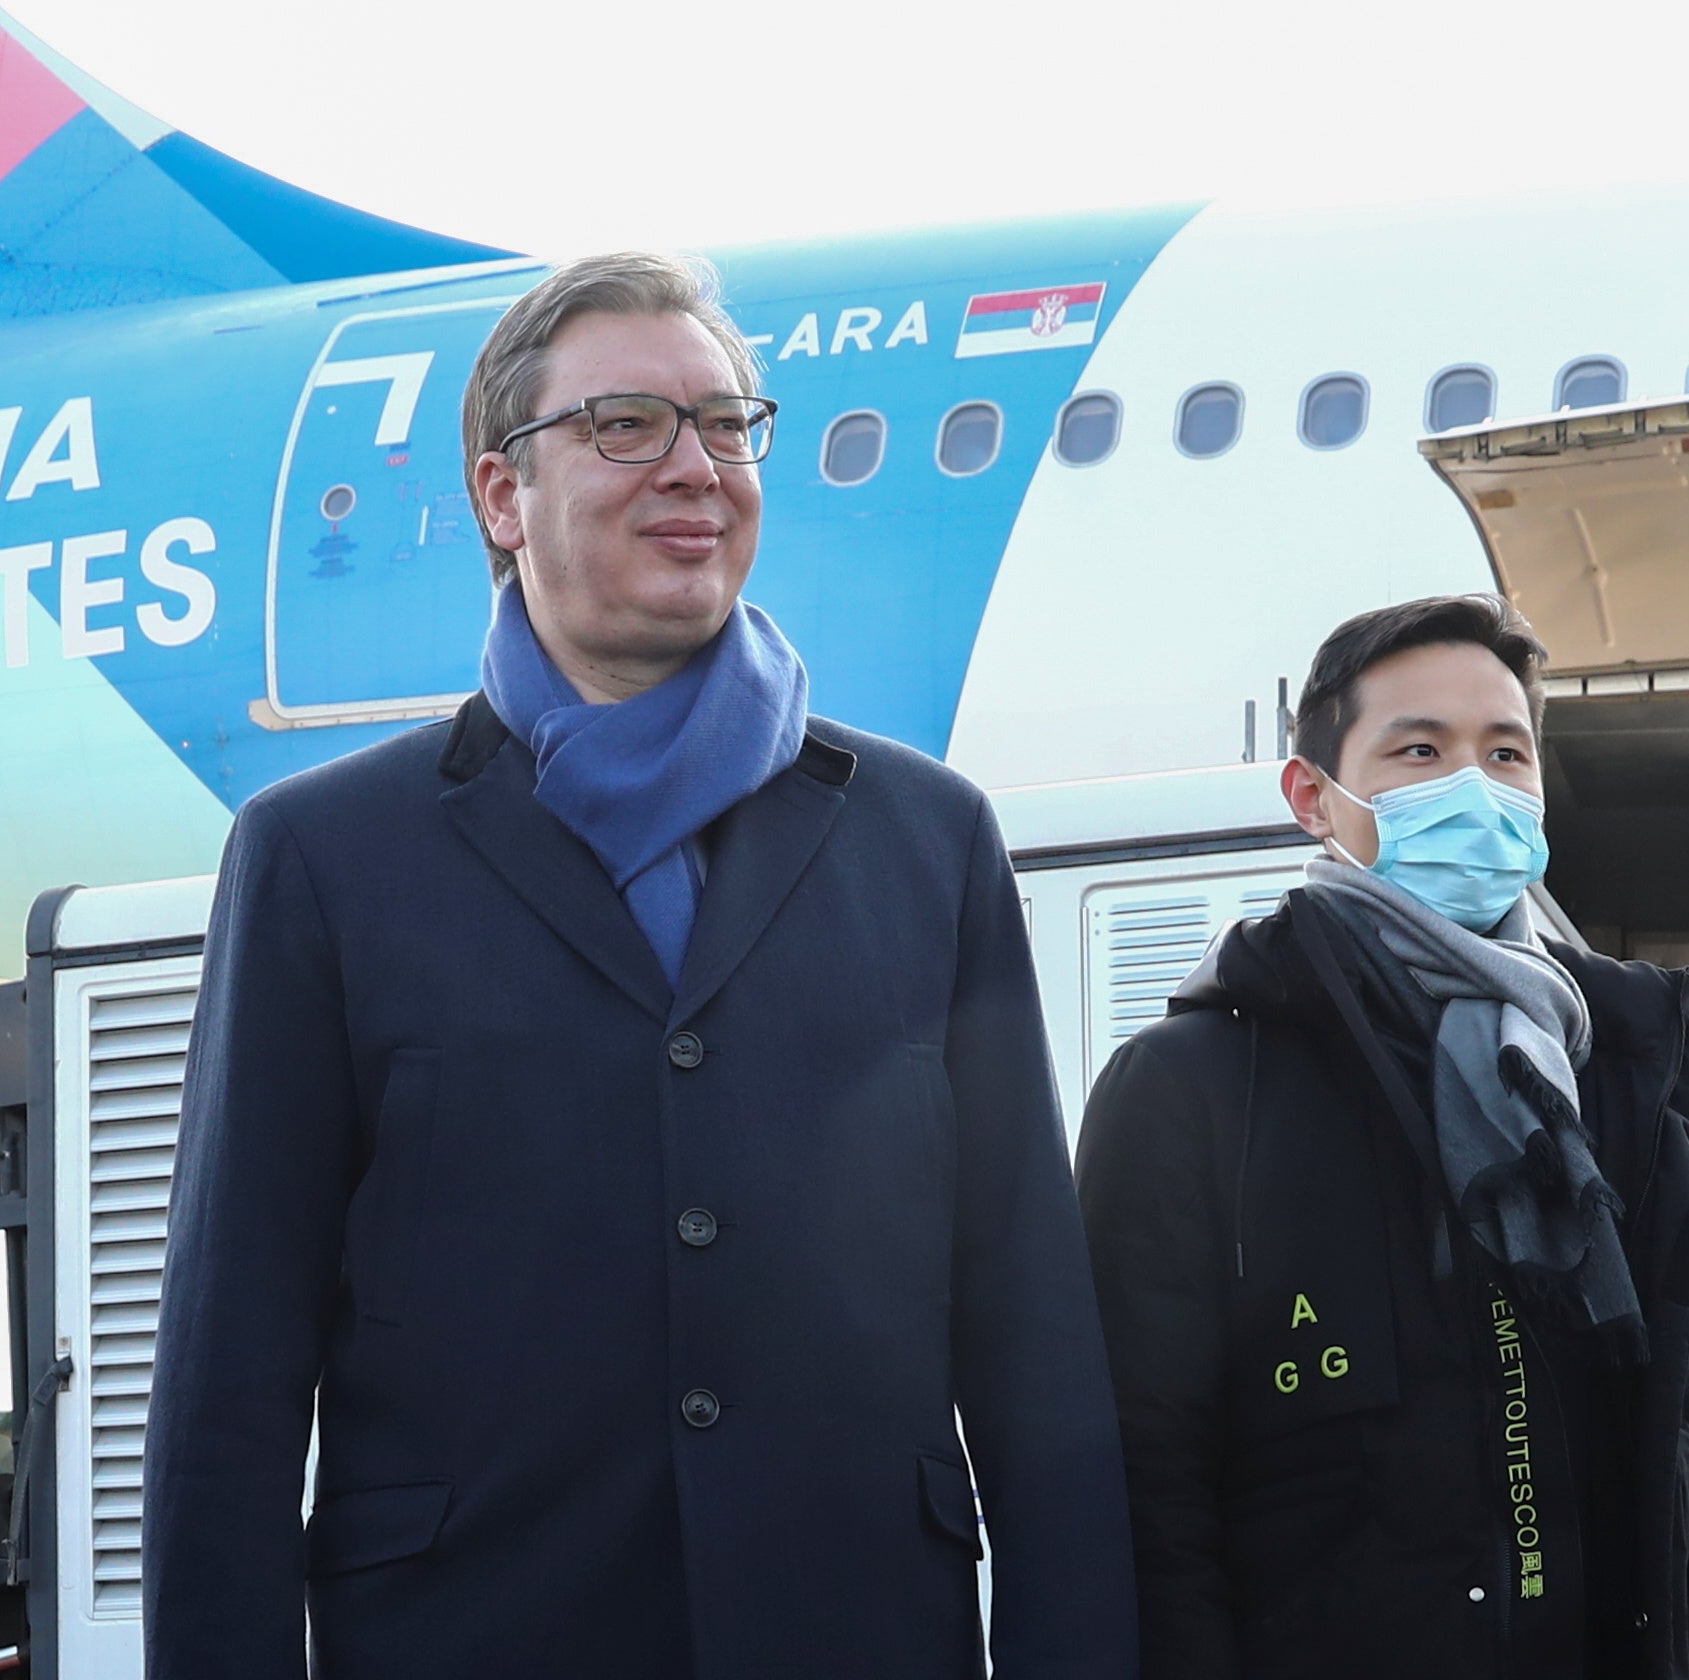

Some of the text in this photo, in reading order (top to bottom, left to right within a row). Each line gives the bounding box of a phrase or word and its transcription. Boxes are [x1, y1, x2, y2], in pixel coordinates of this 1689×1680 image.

[1291, 1293, 1318, 1329] A
[1274, 1345, 1349, 1394] G G
